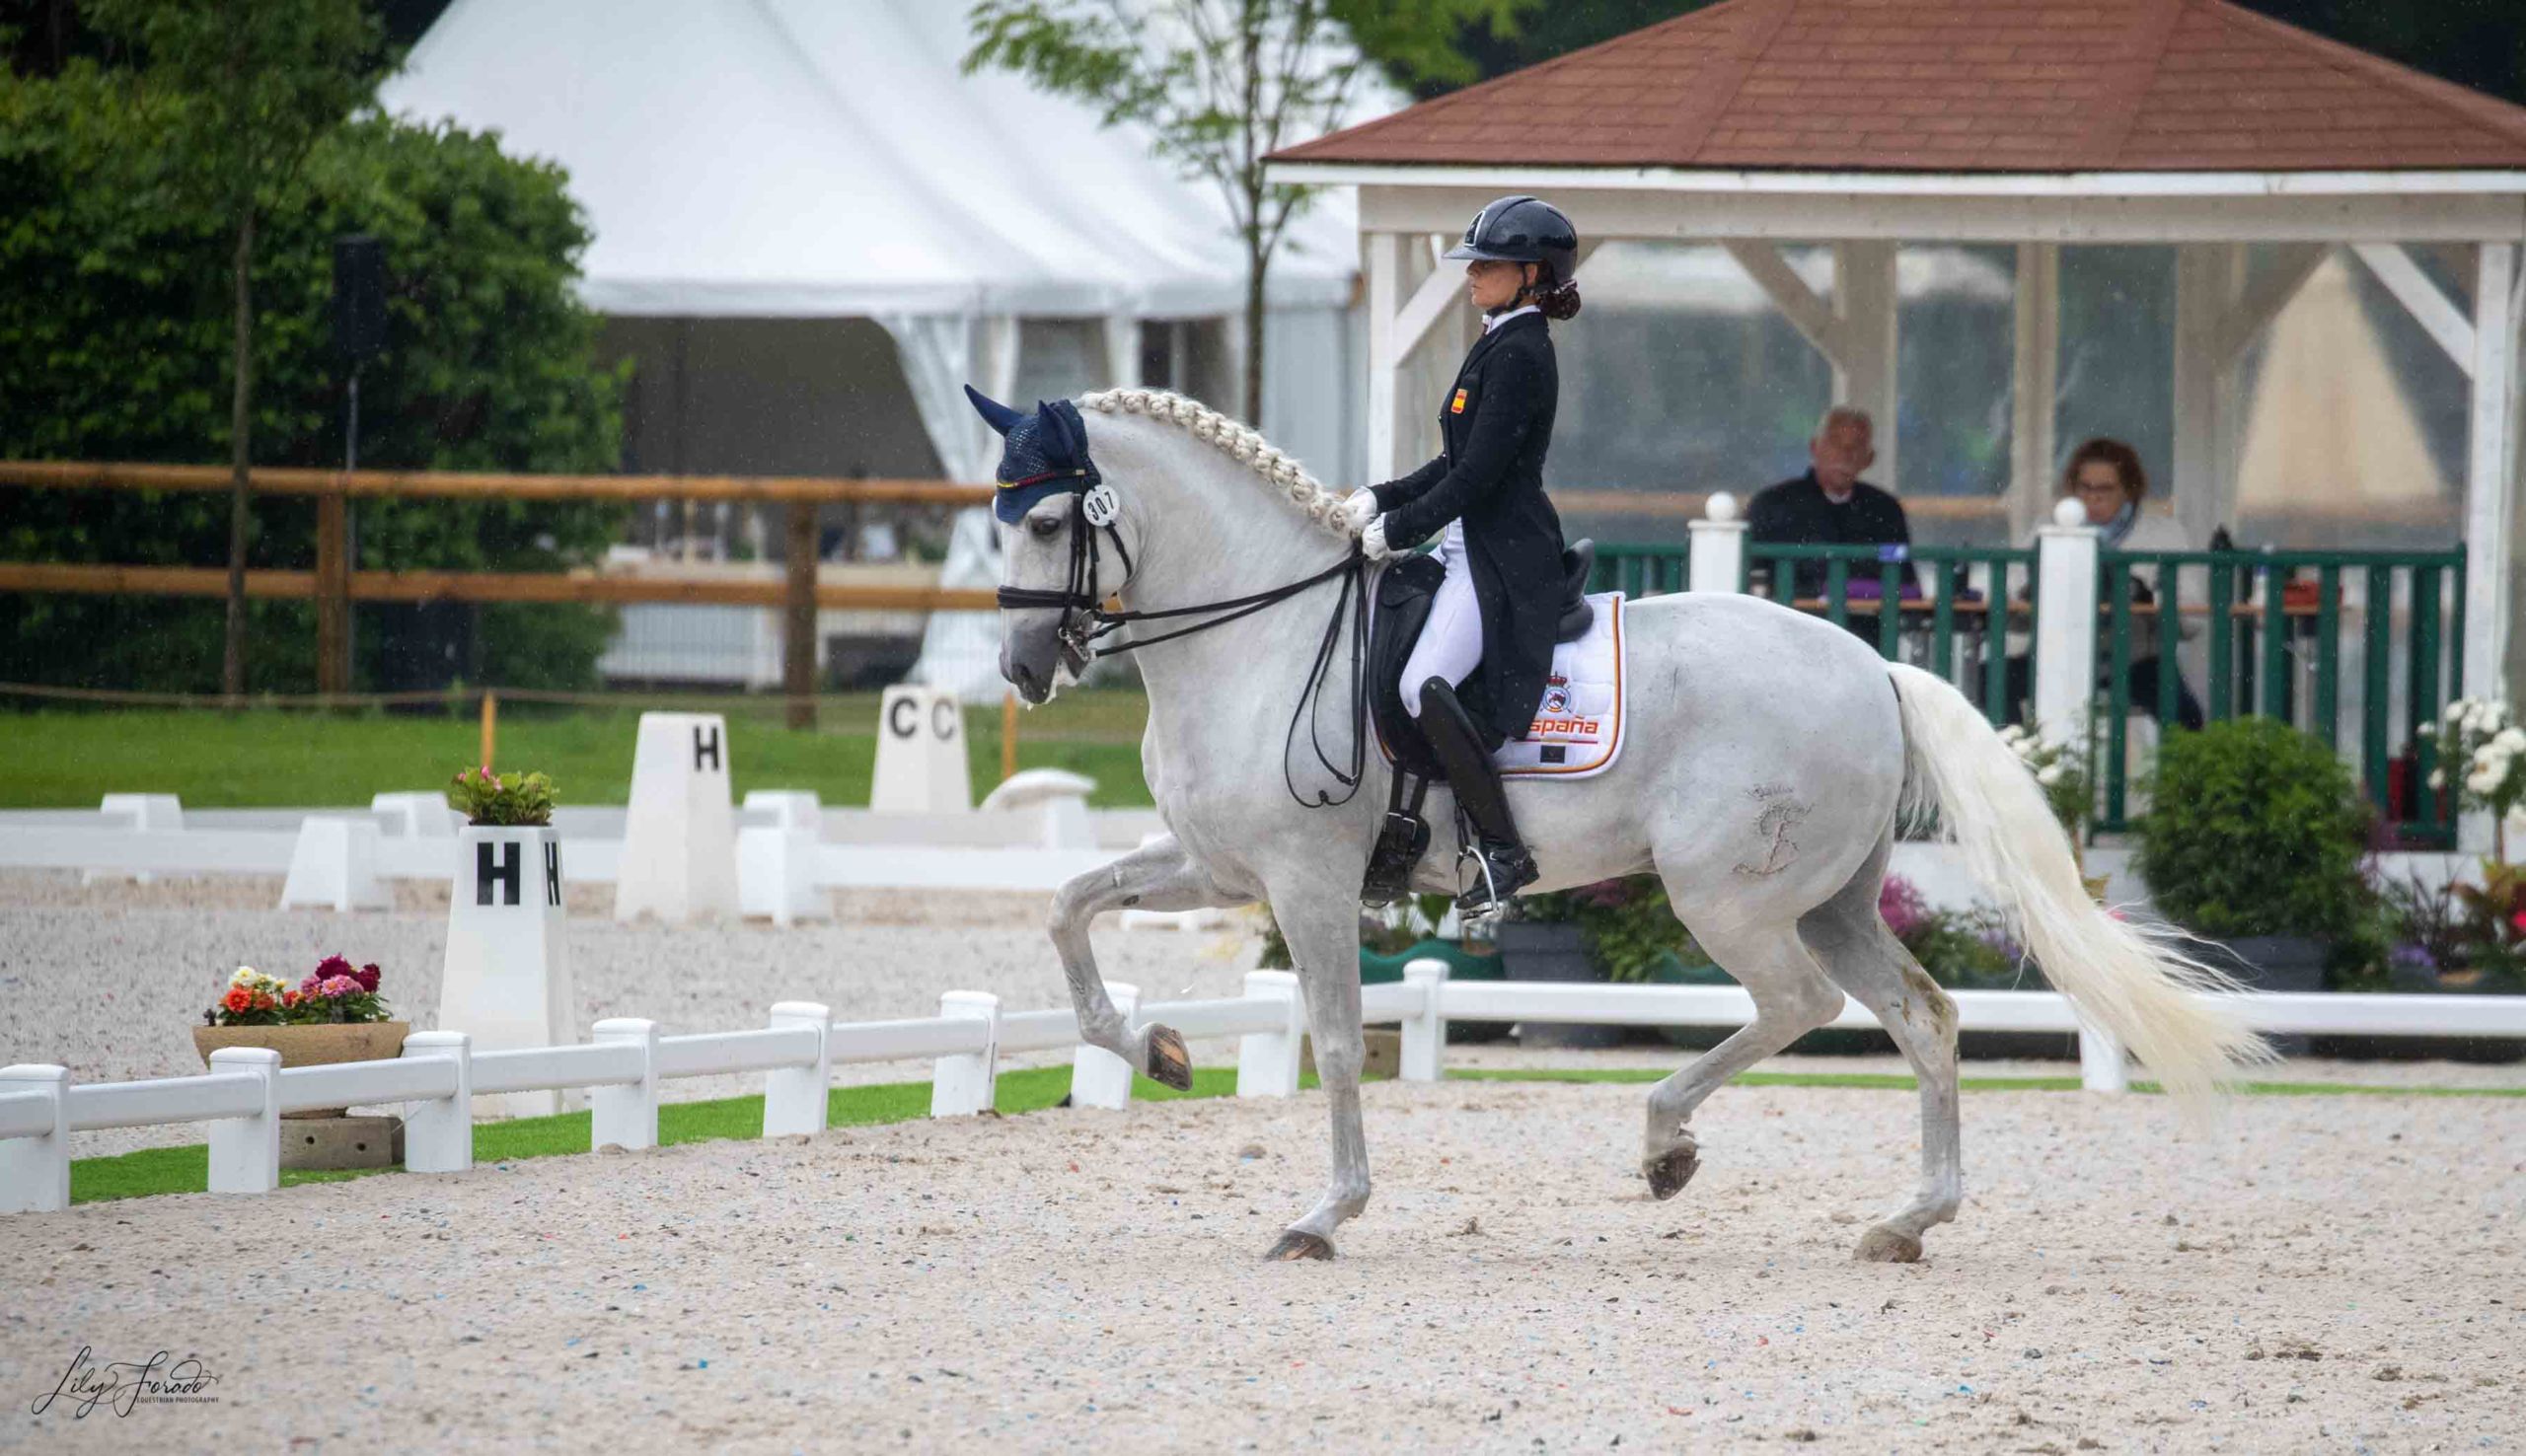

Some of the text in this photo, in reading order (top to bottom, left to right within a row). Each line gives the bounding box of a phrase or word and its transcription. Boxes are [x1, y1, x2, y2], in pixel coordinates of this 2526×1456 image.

[1087, 491, 1114, 521] 307
[890, 697, 918, 739] C
[931, 697, 955, 741] C
[1529, 715, 1599, 737] spaña
[694, 725, 719, 771] H
[478, 842, 520, 906] H
[545, 841, 560, 906] H
